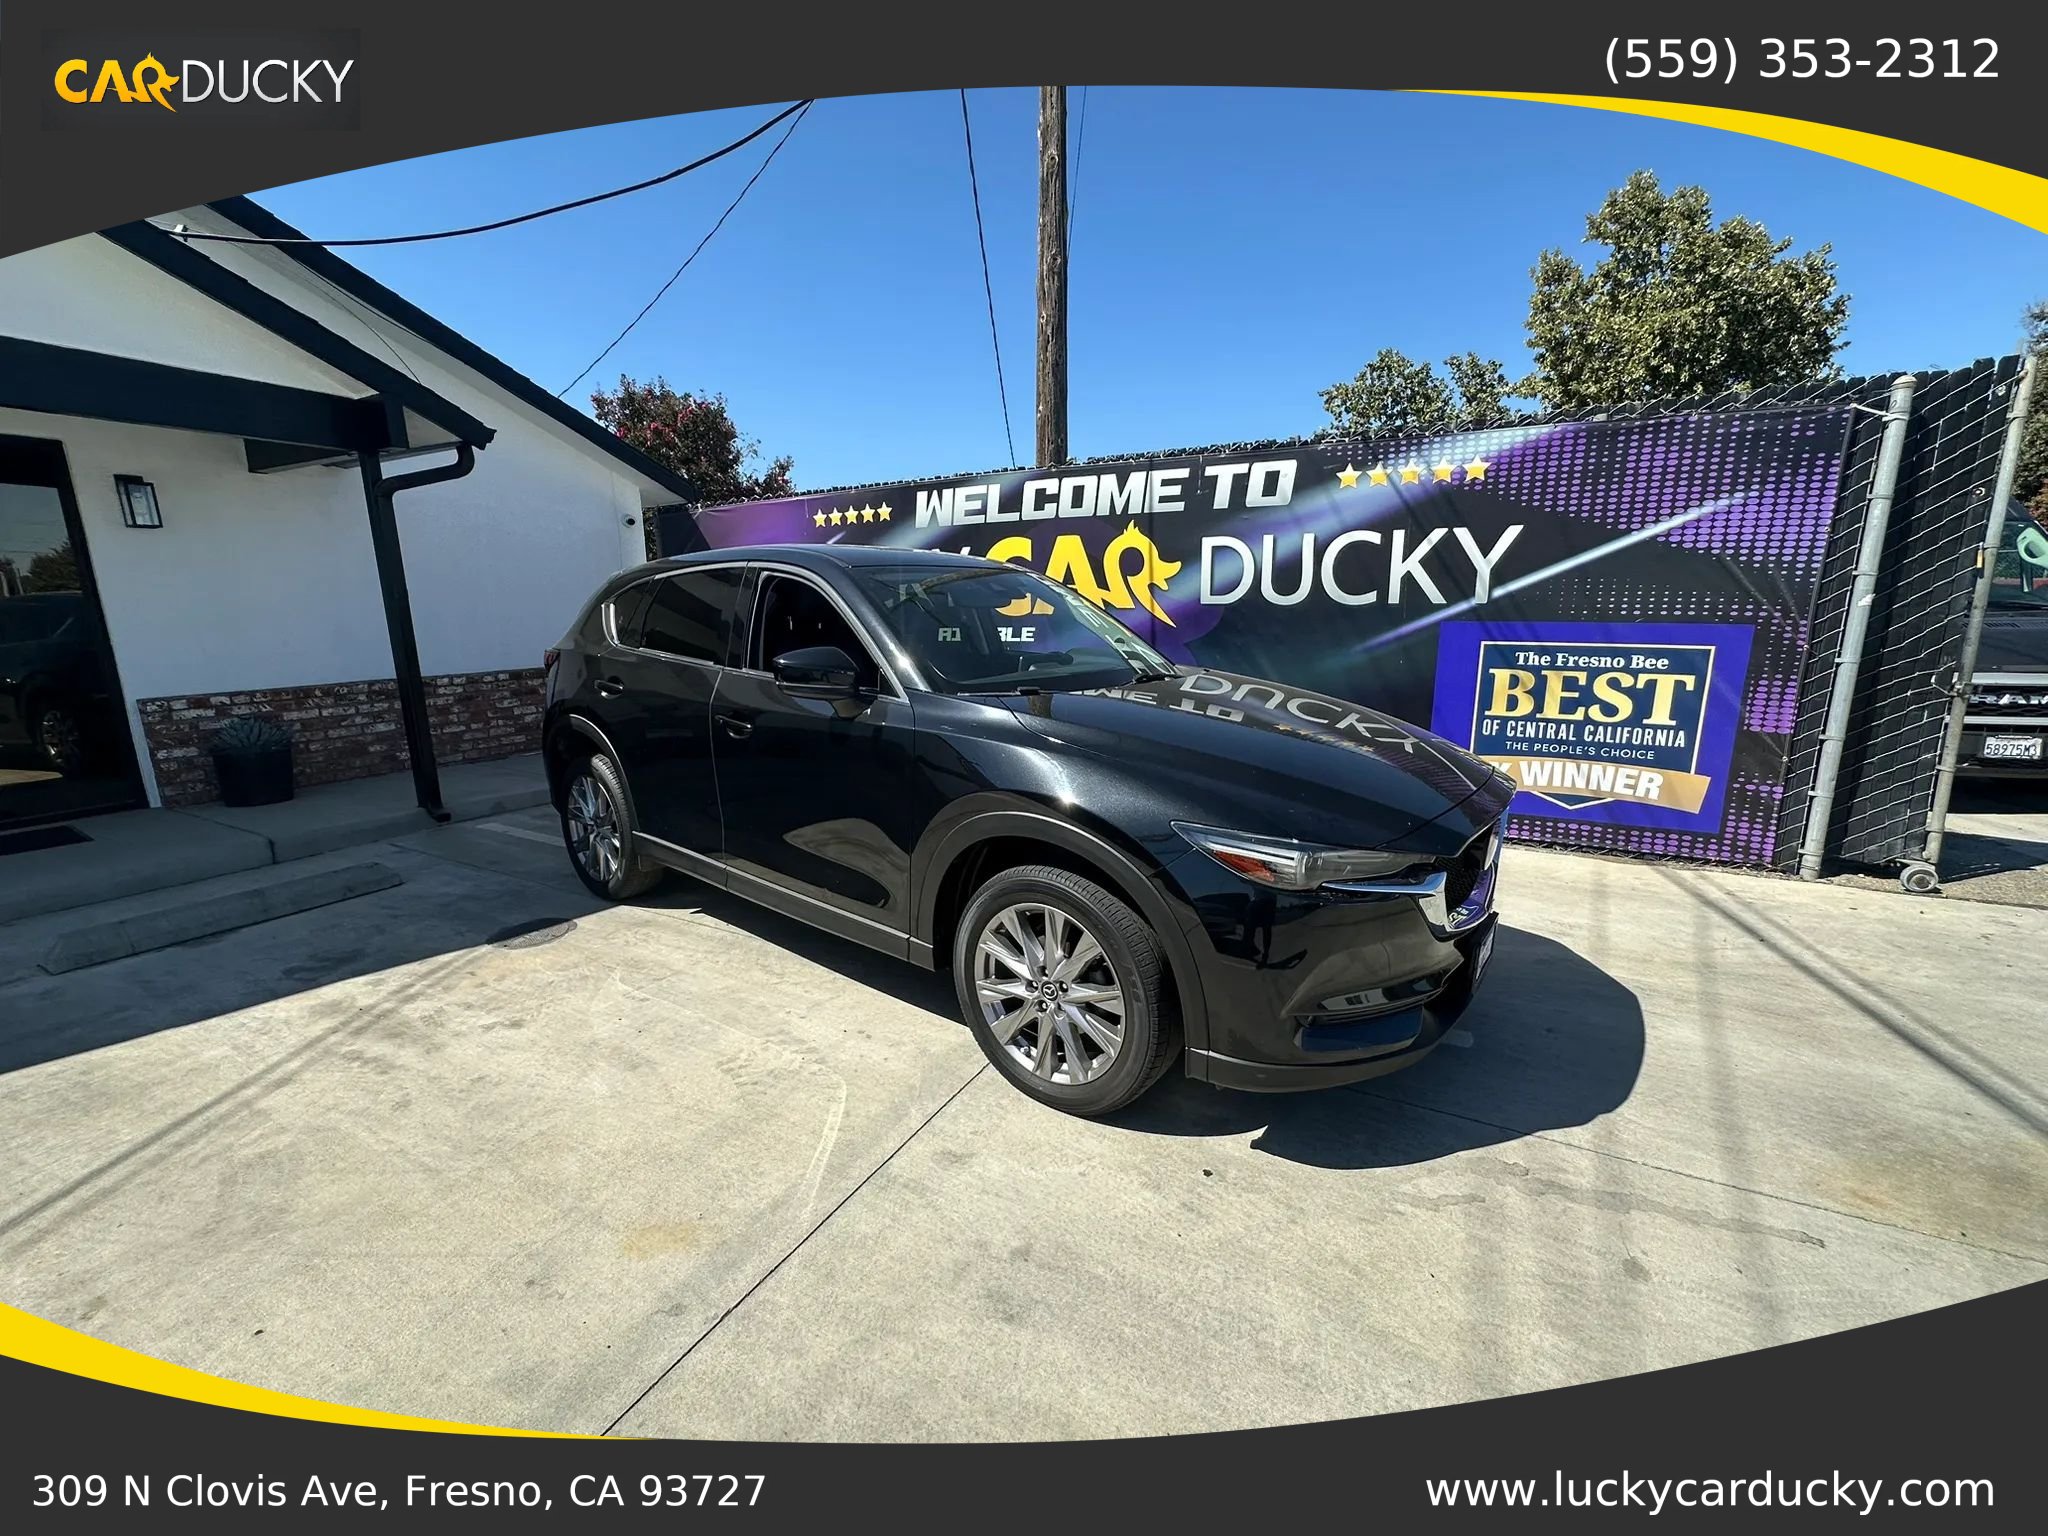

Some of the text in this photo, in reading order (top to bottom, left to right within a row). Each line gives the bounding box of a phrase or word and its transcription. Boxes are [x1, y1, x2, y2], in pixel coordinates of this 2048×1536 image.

[915, 460, 1298, 528] WELCOME TO
[1200, 525, 1524, 606] DUCKY
[1515, 652, 1669, 670] The Fresno Bee
[1484, 668, 1696, 726] BEST
[1482, 719, 1685, 747] OF CENTRAL CALIFORNIA
[1505, 741, 1655, 760] THE PEOPLE'S CHOICE
[1519, 760, 1664, 800] WINNER
